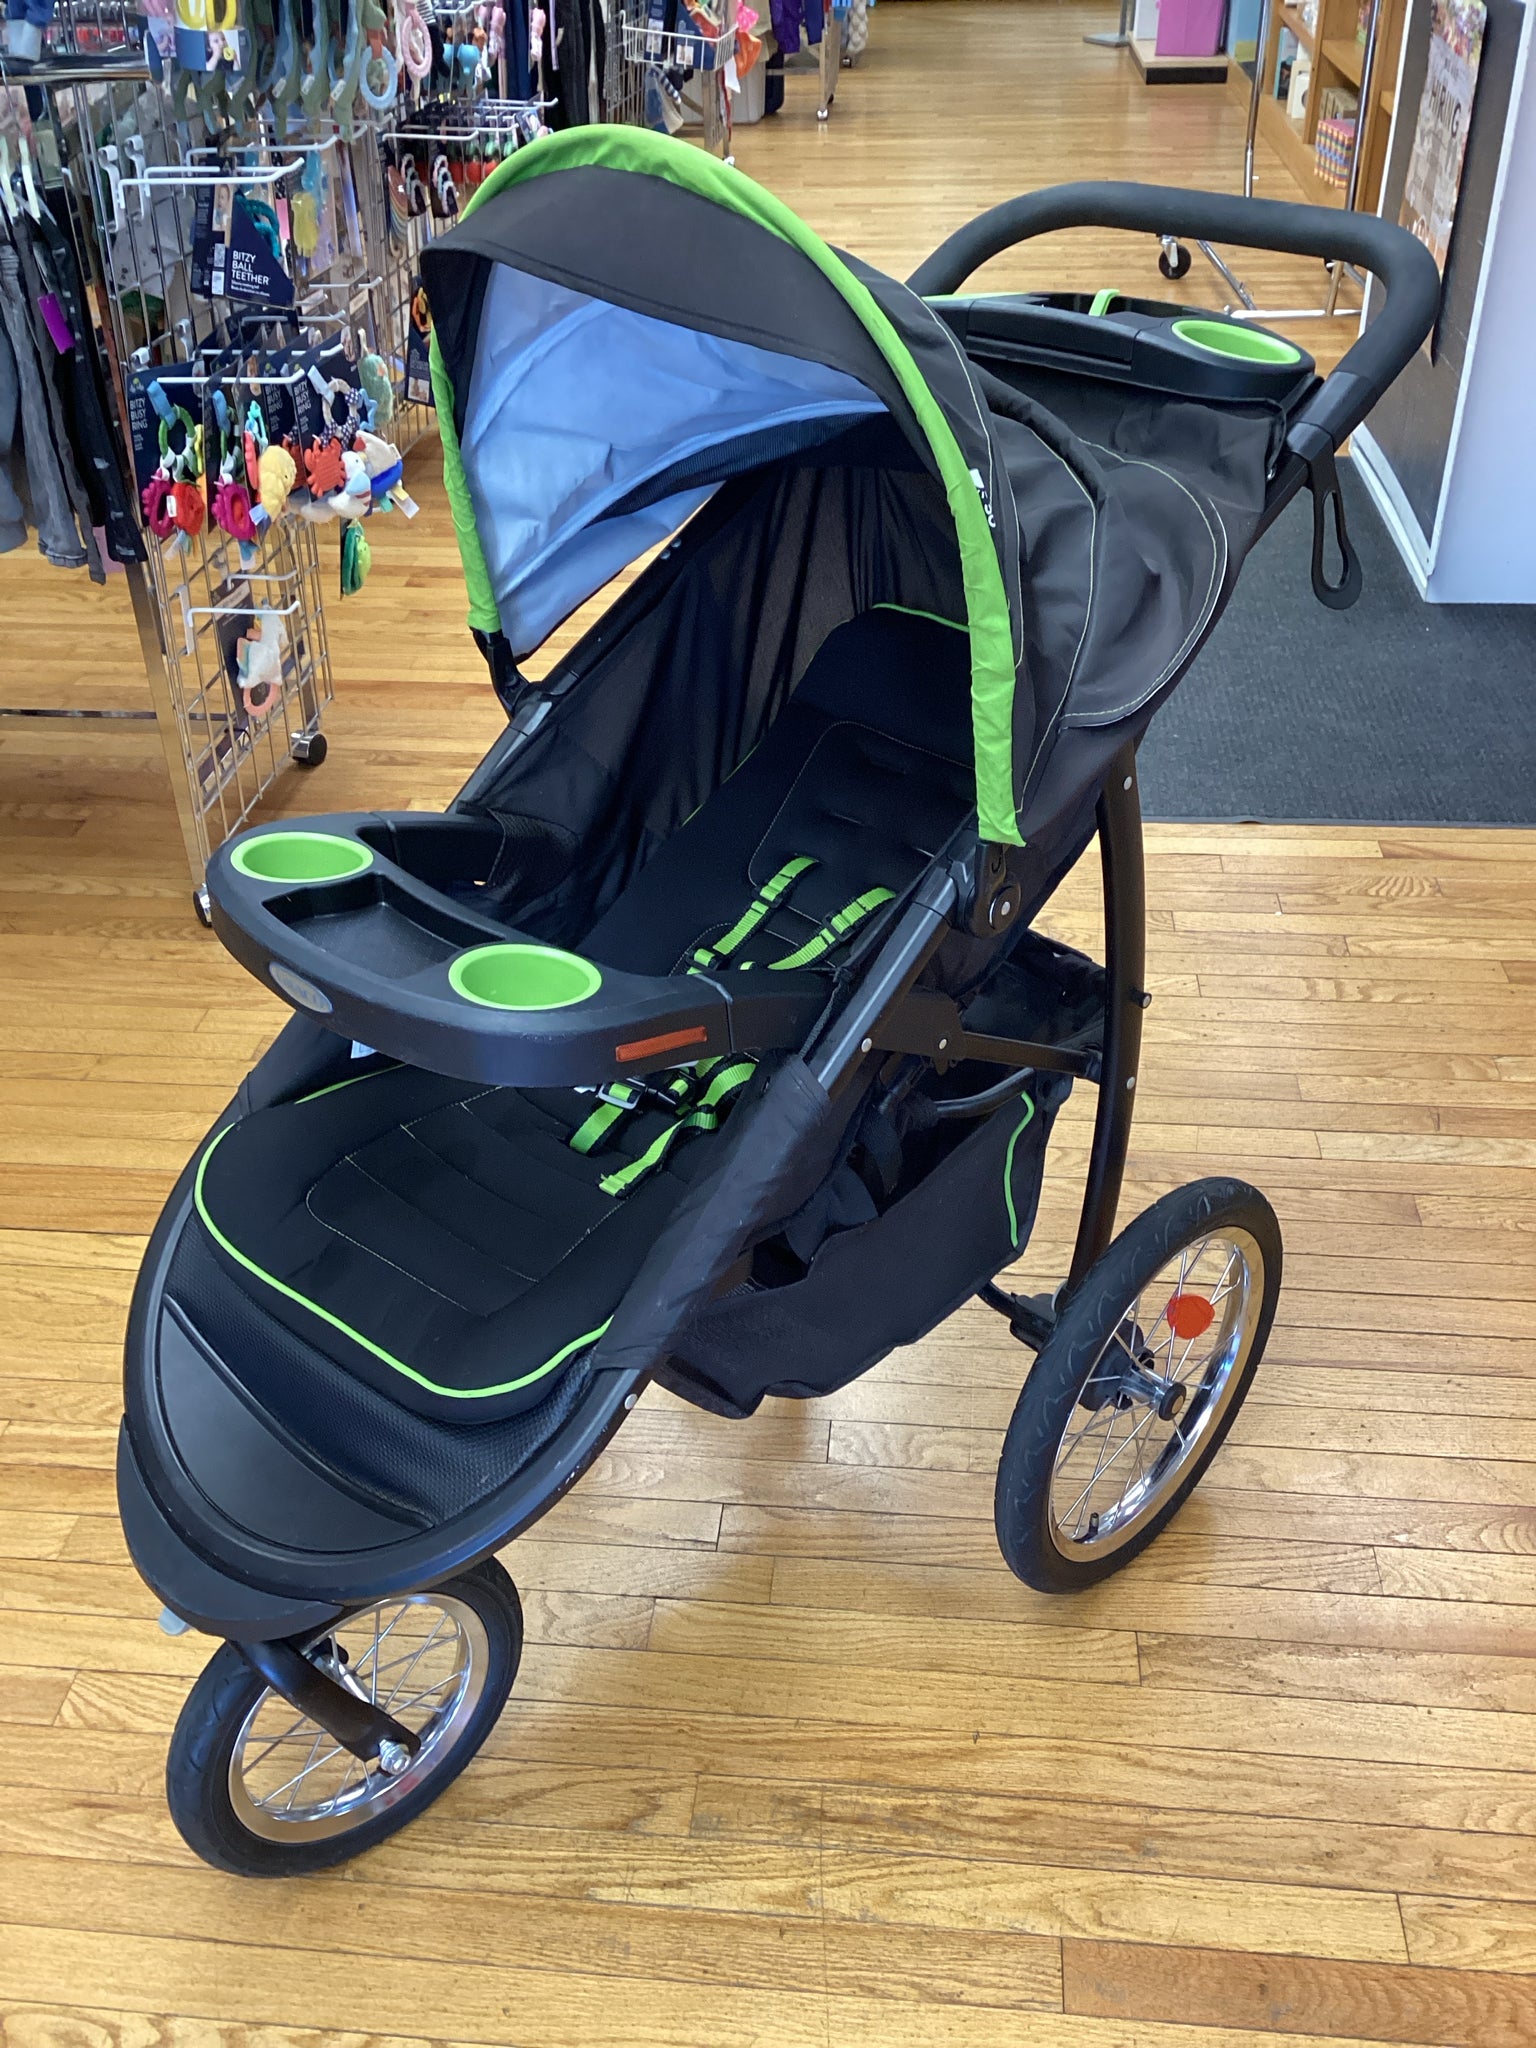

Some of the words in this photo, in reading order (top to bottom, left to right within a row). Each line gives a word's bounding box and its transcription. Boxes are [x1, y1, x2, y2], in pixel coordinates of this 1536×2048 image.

[233, 250, 256, 263] BITZY
[232, 260, 253, 273] BALL
[232, 270, 269, 286] TEETHER
[130, 408, 147, 422] BUSY
[131, 420, 148, 432] RING
